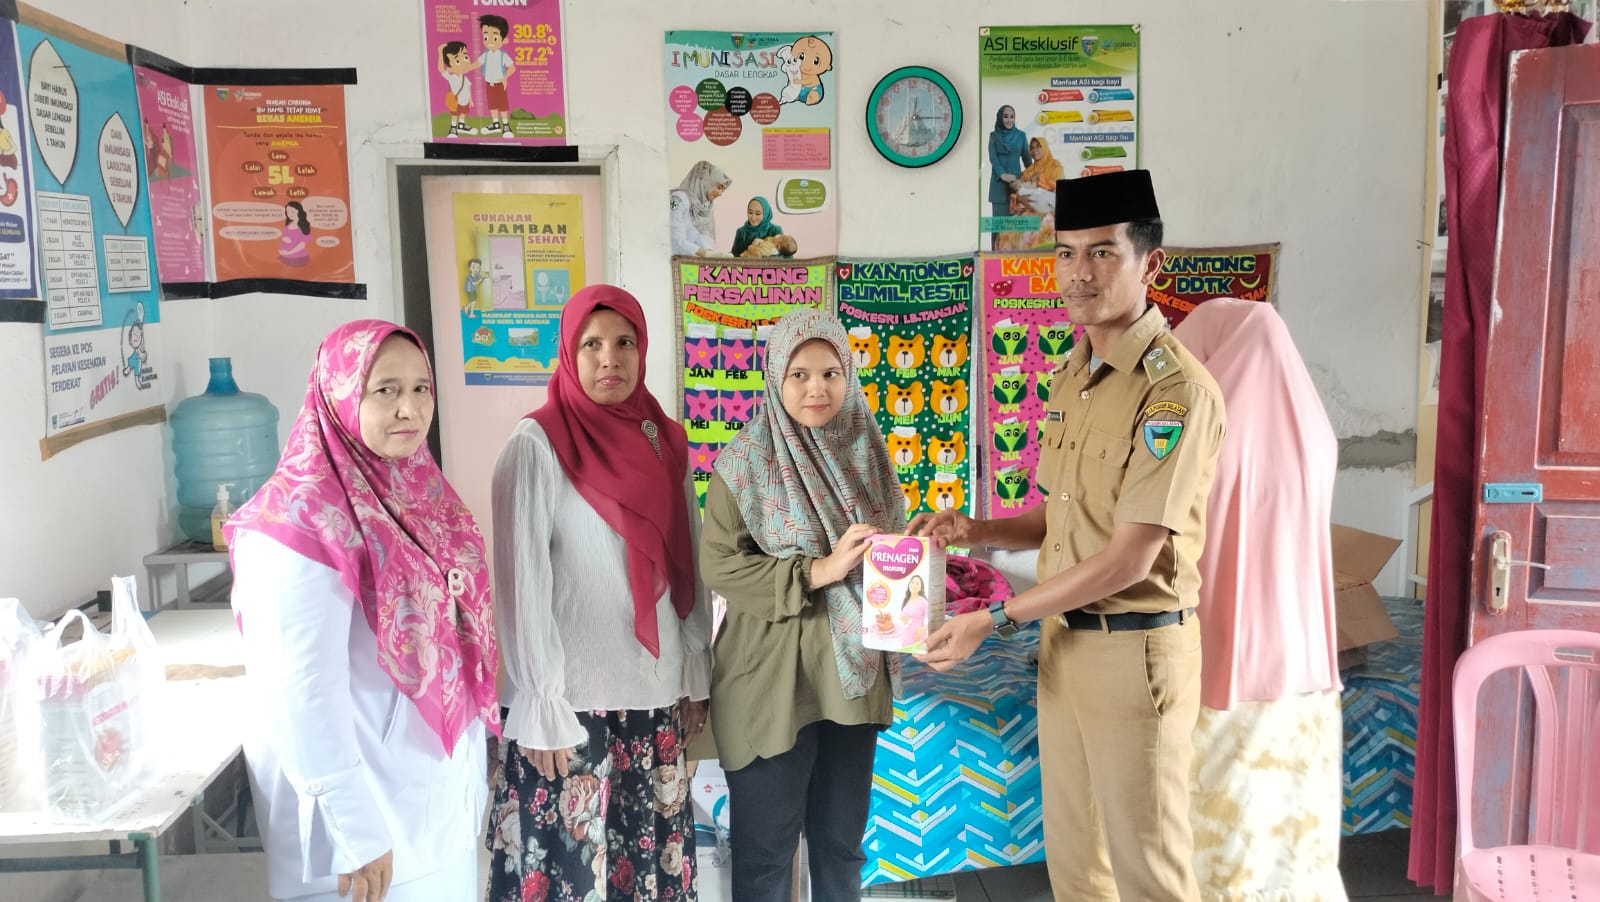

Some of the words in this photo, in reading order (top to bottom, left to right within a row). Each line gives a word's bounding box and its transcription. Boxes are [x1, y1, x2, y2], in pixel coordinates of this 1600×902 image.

[514, 24, 552, 39] 30.8%
[984, 37, 1008, 50] ASI
[1012, 36, 1078, 50] Eksklusif
[514, 46, 554, 62] 37.2%
[672, 50, 777, 70] IMUNISASI
[715, 70, 739, 78] DASAR
[743, 70, 778, 78] LENGKAP
[52, 85, 67, 96] HARUS
[34, 94, 49, 106] DIBERI
[50, 98, 74, 112] IMUNISASI
[36, 108, 50, 120] DASAR
[51, 112, 72, 124] LENGKAP
[45, 125, 65, 136] SEBELUM
[50, 138, 66, 150] TAHUN
[488, 224, 567, 234] JAMBAN
[852, 260, 960, 281] KANTONG
[1001, 257, 1057, 277] KANT
[1160, 255, 1256, 274] KANTONG
[698, 266, 808, 284] KANTONG
[840, 284, 906, 303] BUMIL
[909, 281, 970, 302] RESTI
[1176, 276, 1235, 294] DDTK
[684, 284, 822, 305] PERSALINAN
[994, 298, 1055, 309] POSKESRI
[686, 302, 752, 329] POSKESRI
[840, 302, 899, 324] POSKESRI
[50, 345, 72, 359] SEGERA
[72, 344, 80, 354] KE
[81, 342, 92, 353] POS
[52, 362, 76, 376] PELAYAN
[77, 356, 106, 371] KESEHATAN
[689, 369, 714, 378] JAN
[726, 370, 748, 379] FEB
[857, 368, 873, 377] AN
[896, 368, 917, 378] FEB
[937, 367, 960, 376] MAR
[52, 378, 82, 392] TERDEKAT
[691, 420, 709, 430] MEI
[894, 415, 914, 425] MEI
[938, 412, 962, 423] JUN
[872, 552, 919, 563] PRENAGEN
